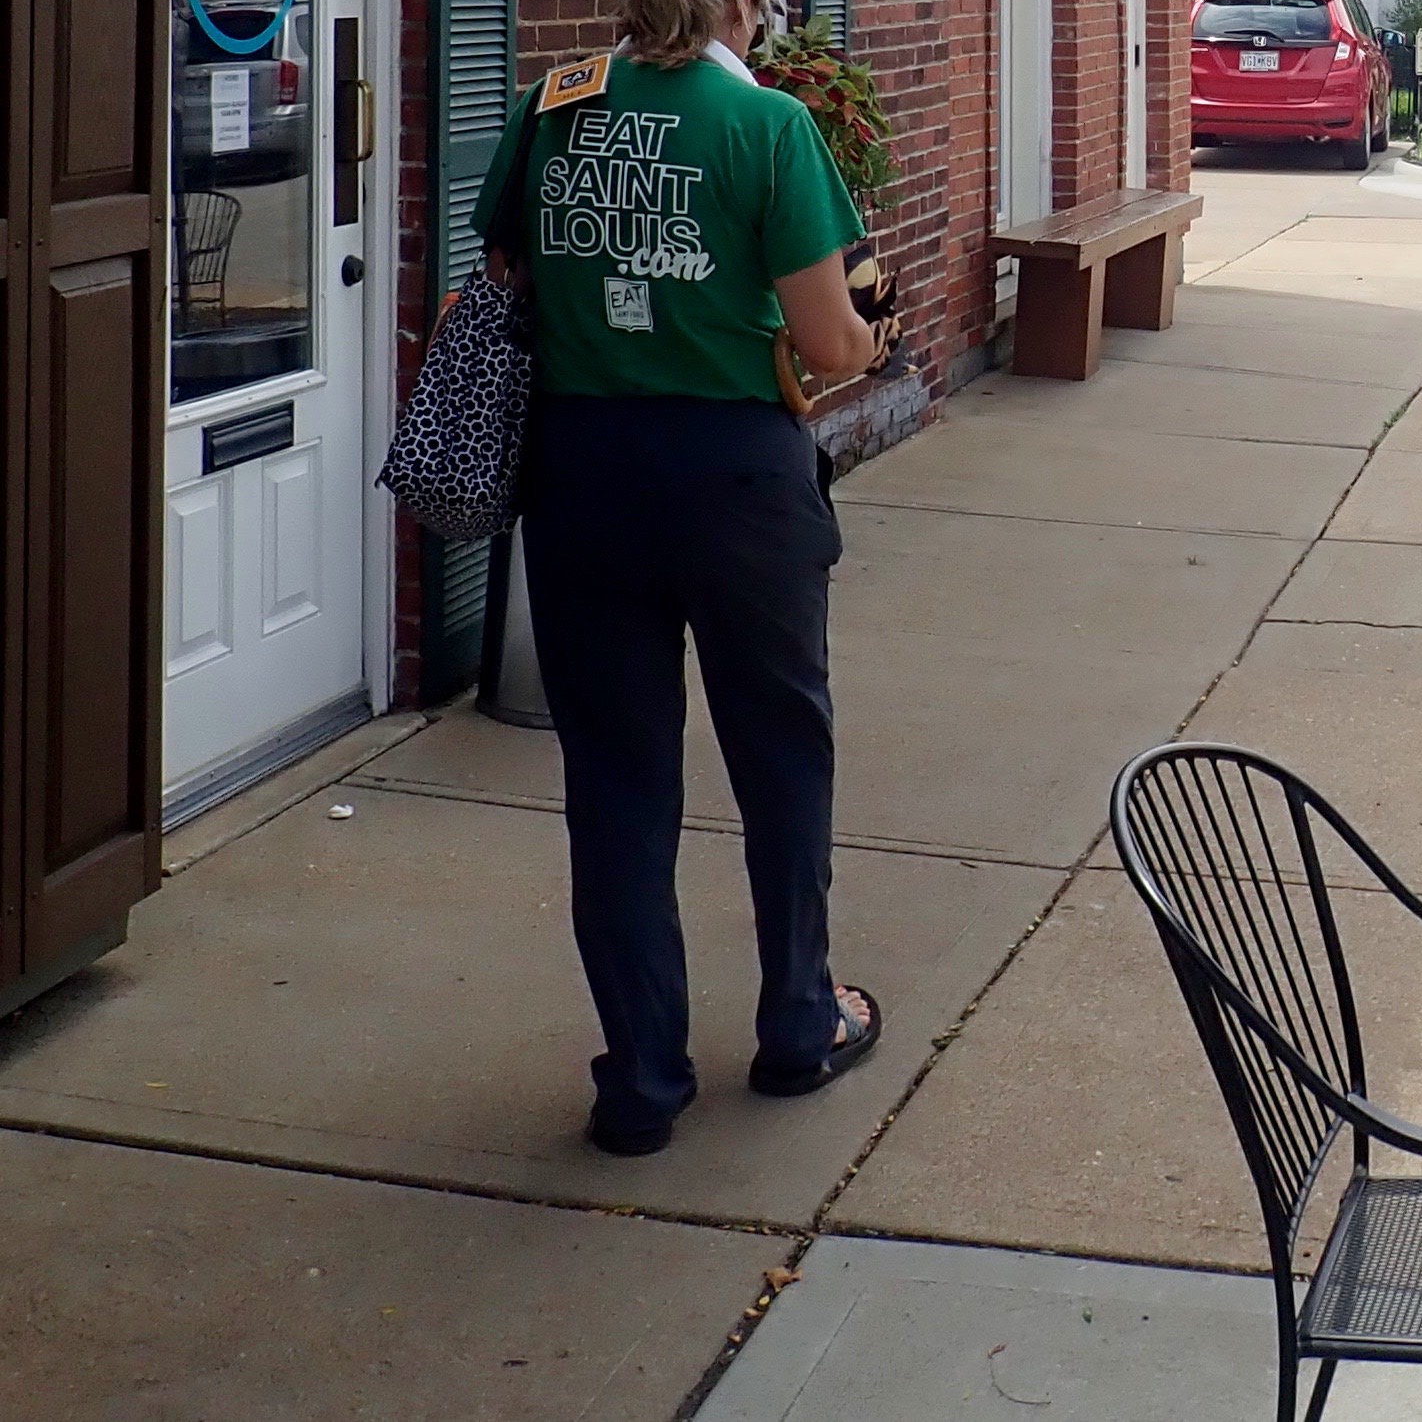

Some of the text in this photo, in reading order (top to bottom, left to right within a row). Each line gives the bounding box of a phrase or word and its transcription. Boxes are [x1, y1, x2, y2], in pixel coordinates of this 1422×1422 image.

[568, 108, 681, 160] EAT
[540, 156, 703, 214] SAINT
[541, 208, 702, 260] LOUIS
[617, 247, 716, 281] .com
[611, 285, 643, 308] EAT
